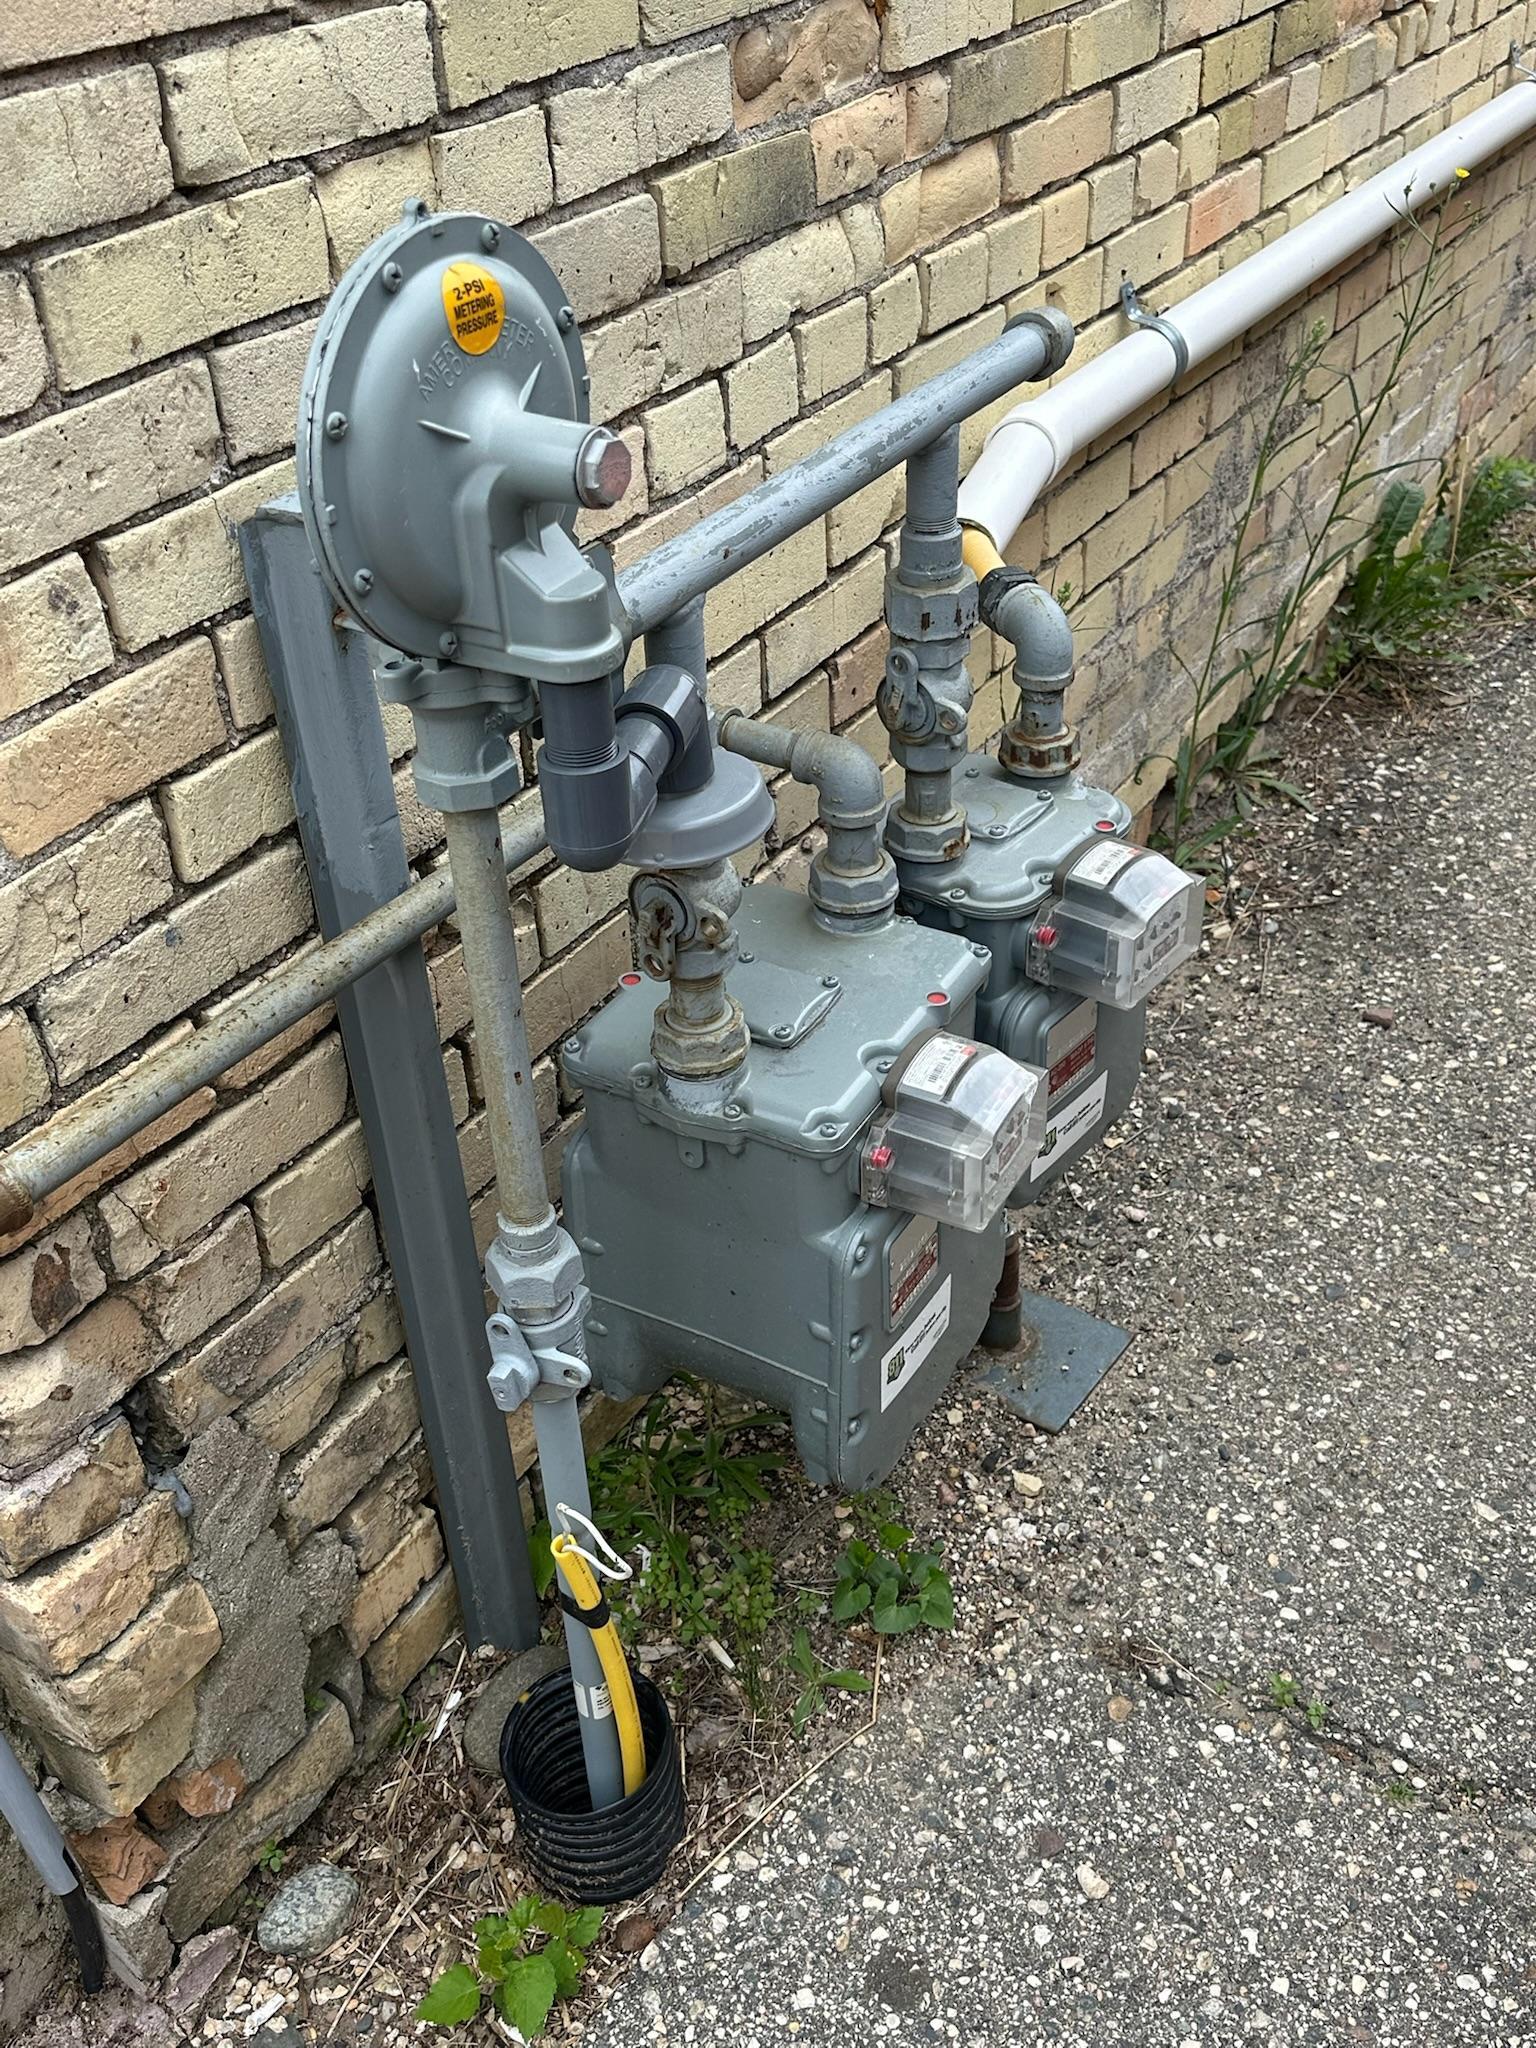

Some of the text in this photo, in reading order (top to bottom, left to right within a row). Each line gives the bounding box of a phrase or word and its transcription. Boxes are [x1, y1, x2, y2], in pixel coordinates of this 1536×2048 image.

[453, 279, 485, 301] 2-PSI
[454, 293, 495, 320] METERING
[456, 310, 498, 338] PRESSURE
[887, 1347, 904, 1378] 811
